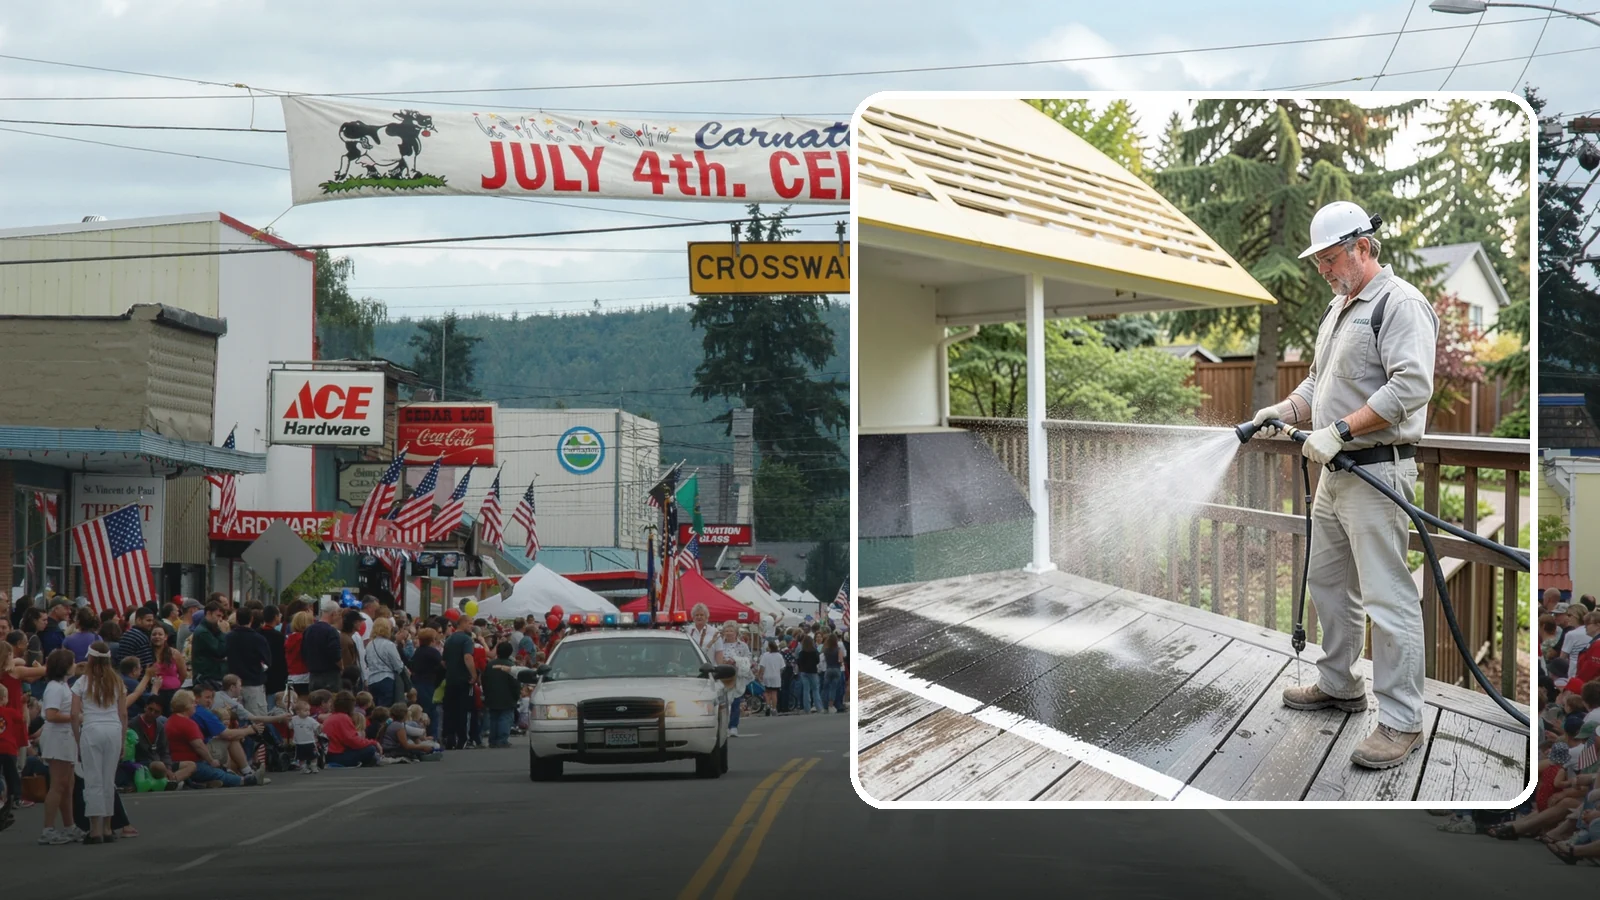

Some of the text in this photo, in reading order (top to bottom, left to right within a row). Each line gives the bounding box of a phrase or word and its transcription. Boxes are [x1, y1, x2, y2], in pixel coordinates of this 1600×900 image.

[695, 121, 849, 149] Carnat
[481, 141, 605, 192] JULY
[632, 150, 746, 198] 4th.
[697, 254, 849, 280] CROSSWA
[282, 380, 373, 420] ACE
[405, 409, 452, 421] CEDAR
[283, 421, 370, 436] Hardware
[416, 428, 477, 446] Coca-Cola
[354, 467, 386, 480] Simpl
[95, 485, 124, 494] Vincent
[126, 486, 135, 494] de
[137, 486, 155, 495] Paul
[688, 526, 741, 534] CRNATION
